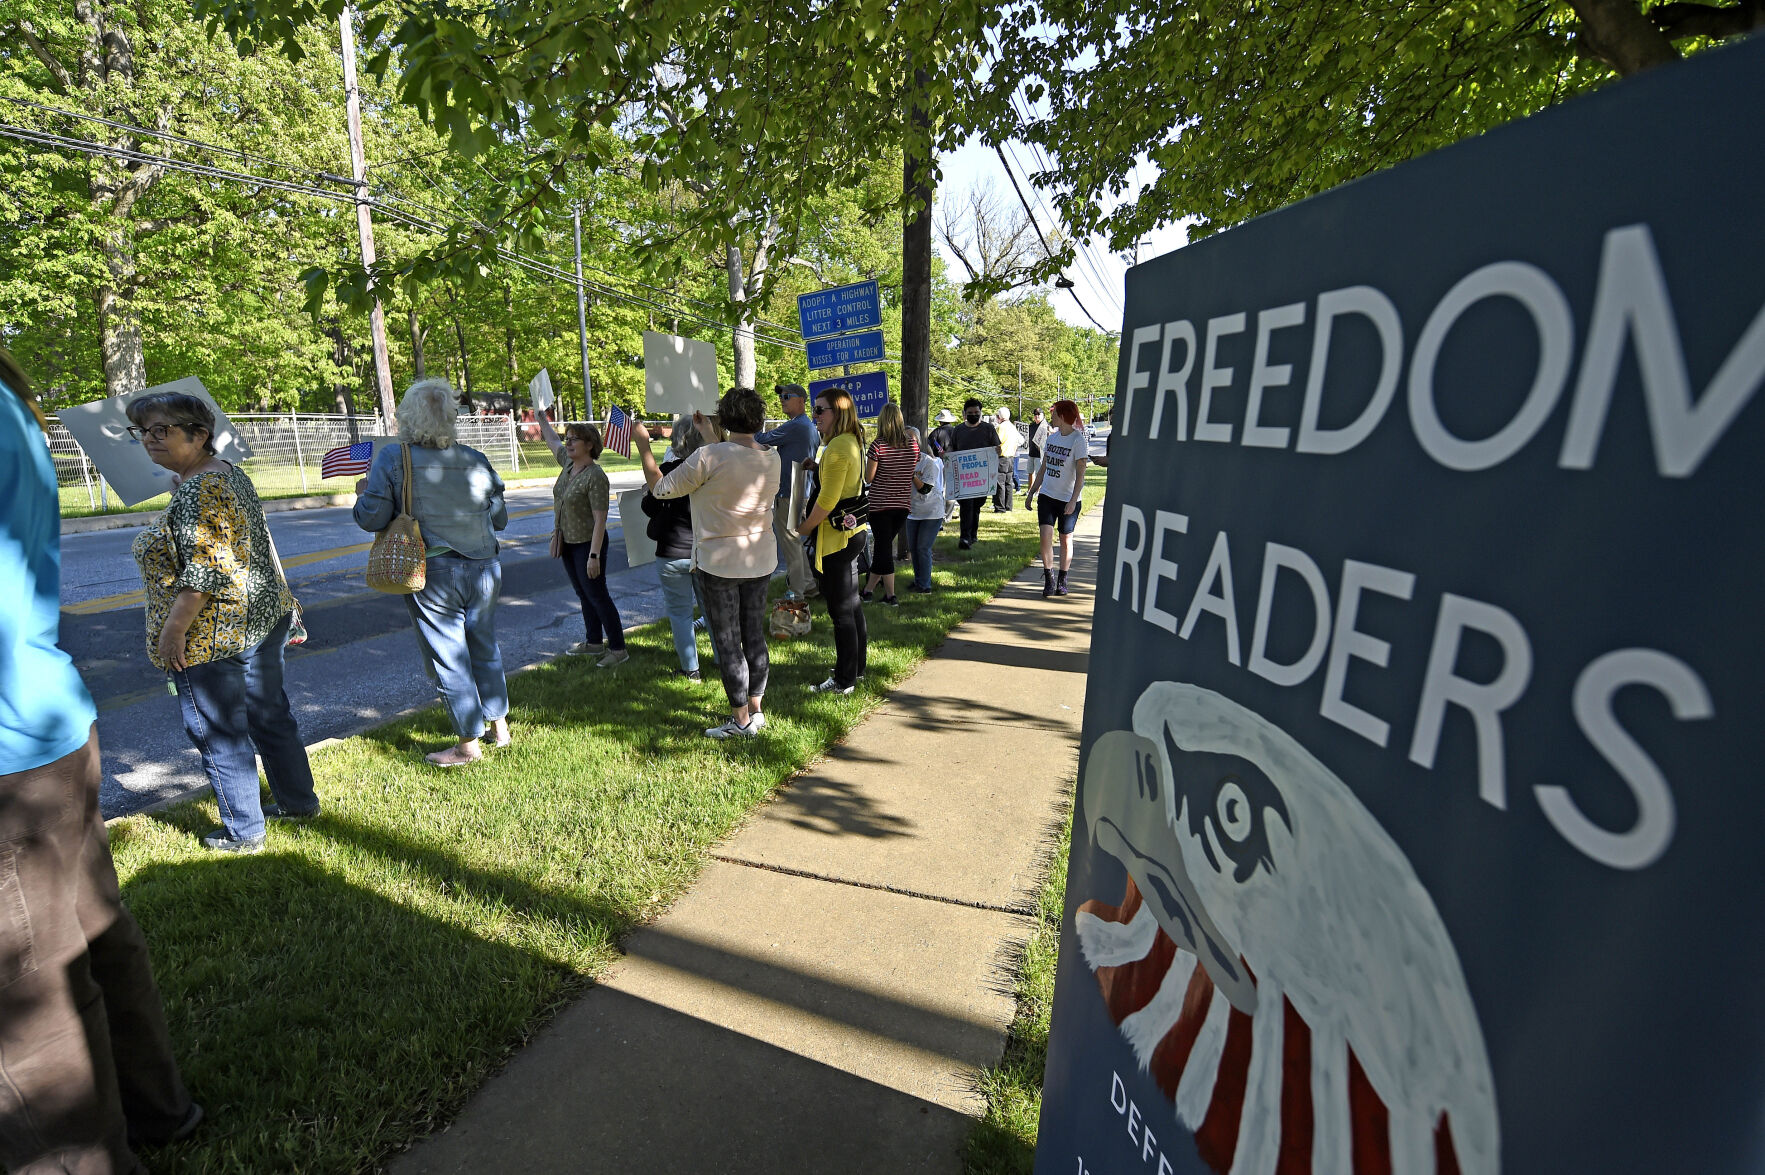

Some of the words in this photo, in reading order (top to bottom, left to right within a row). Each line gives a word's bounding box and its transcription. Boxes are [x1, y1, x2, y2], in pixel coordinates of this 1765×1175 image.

[802, 295, 826, 309] ADOPT
[831, 293, 837, 303] A
[841, 285, 874, 301] HIGHWAY
[806, 308, 832, 321] LITTER
[837, 300, 872, 315] CONTROL
[812, 321, 831, 333] NEXT
[836, 319, 842, 328] 3
[846, 313, 870, 327] MILES
[826, 337, 860, 351] OPERATION
[836, 351, 849, 361] FOR
[832, 381, 862, 391] Keep
[958, 454, 977, 463] FREE
[1046, 455, 1065, 467] RANS
[961, 460, 989, 470] PEOPLE
[960, 471, 979, 480] READ
[962, 478, 987, 488] FREELY
[1112, 504, 1716, 870] READERS
